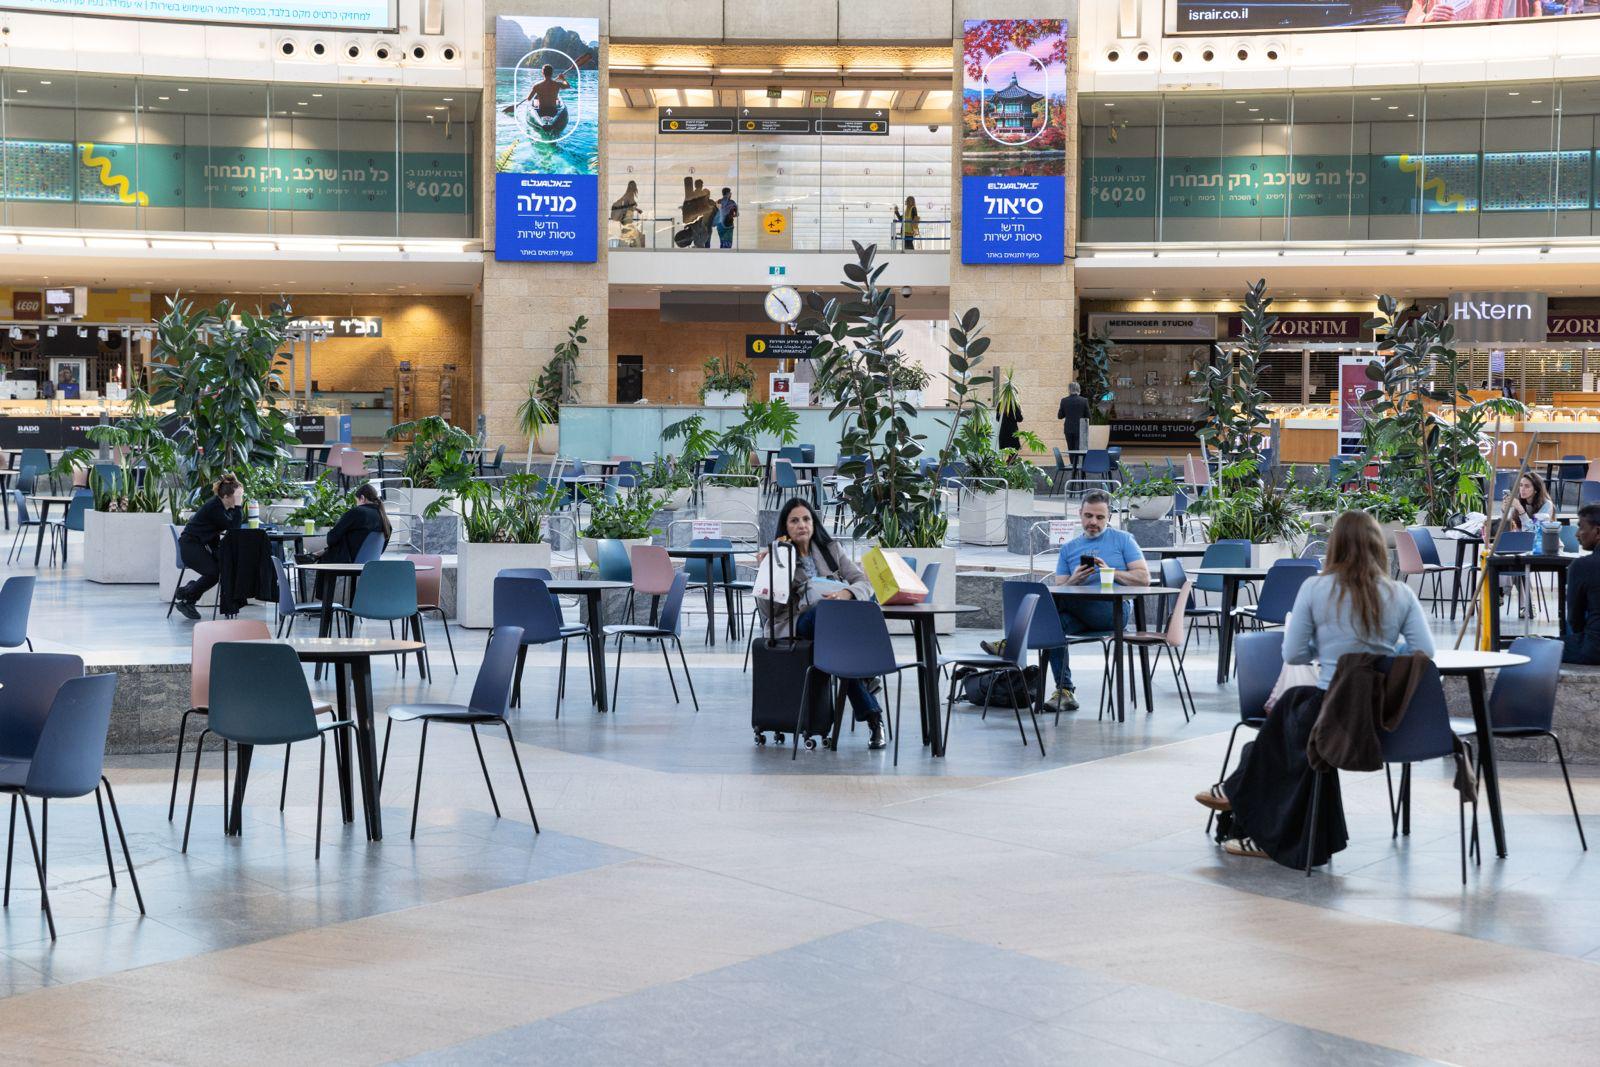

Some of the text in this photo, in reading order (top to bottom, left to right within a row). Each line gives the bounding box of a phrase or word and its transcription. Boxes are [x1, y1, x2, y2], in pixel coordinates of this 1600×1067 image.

[150, 2, 180, 12] בשירות
[182, 4, 214, 13] השימוש
[216, 5, 240, 15] לתנאי
[242, 6, 266, 17] בכפוף
[268, 8, 290, 18] בלבד,
[292, 10, 310, 18] מקס
[312, 10, 338, 20] כרטיס
[339, 11, 371, 21] למחזיקי
[1188, 8, 1248, 20] israir.co.il
[204, 165, 256, 178] תבחרו
[260, 166, 282, 183] רק
[342, 168, 366, 181] מה
[370, 166, 389, 182] כל
[1345, 168, 1367, 185] כל
[1169, 174, 1224, 188] תבחרו
[1228, 173, 1251, 191] רק
[1315, 172, 1340, 185] מה
[517, 192, 577, 212] מנילה
[984, 196, 1044, 214] סיאול
[534, 220, 558, 230] חדש!
[1001, 223, 1025, 232] חדש!
[517, 230, 576, 240] טיסות ישירות
[984, 234, 1042, 242] טיסות ישירות
[16, 301, 38, 310] LEGO
